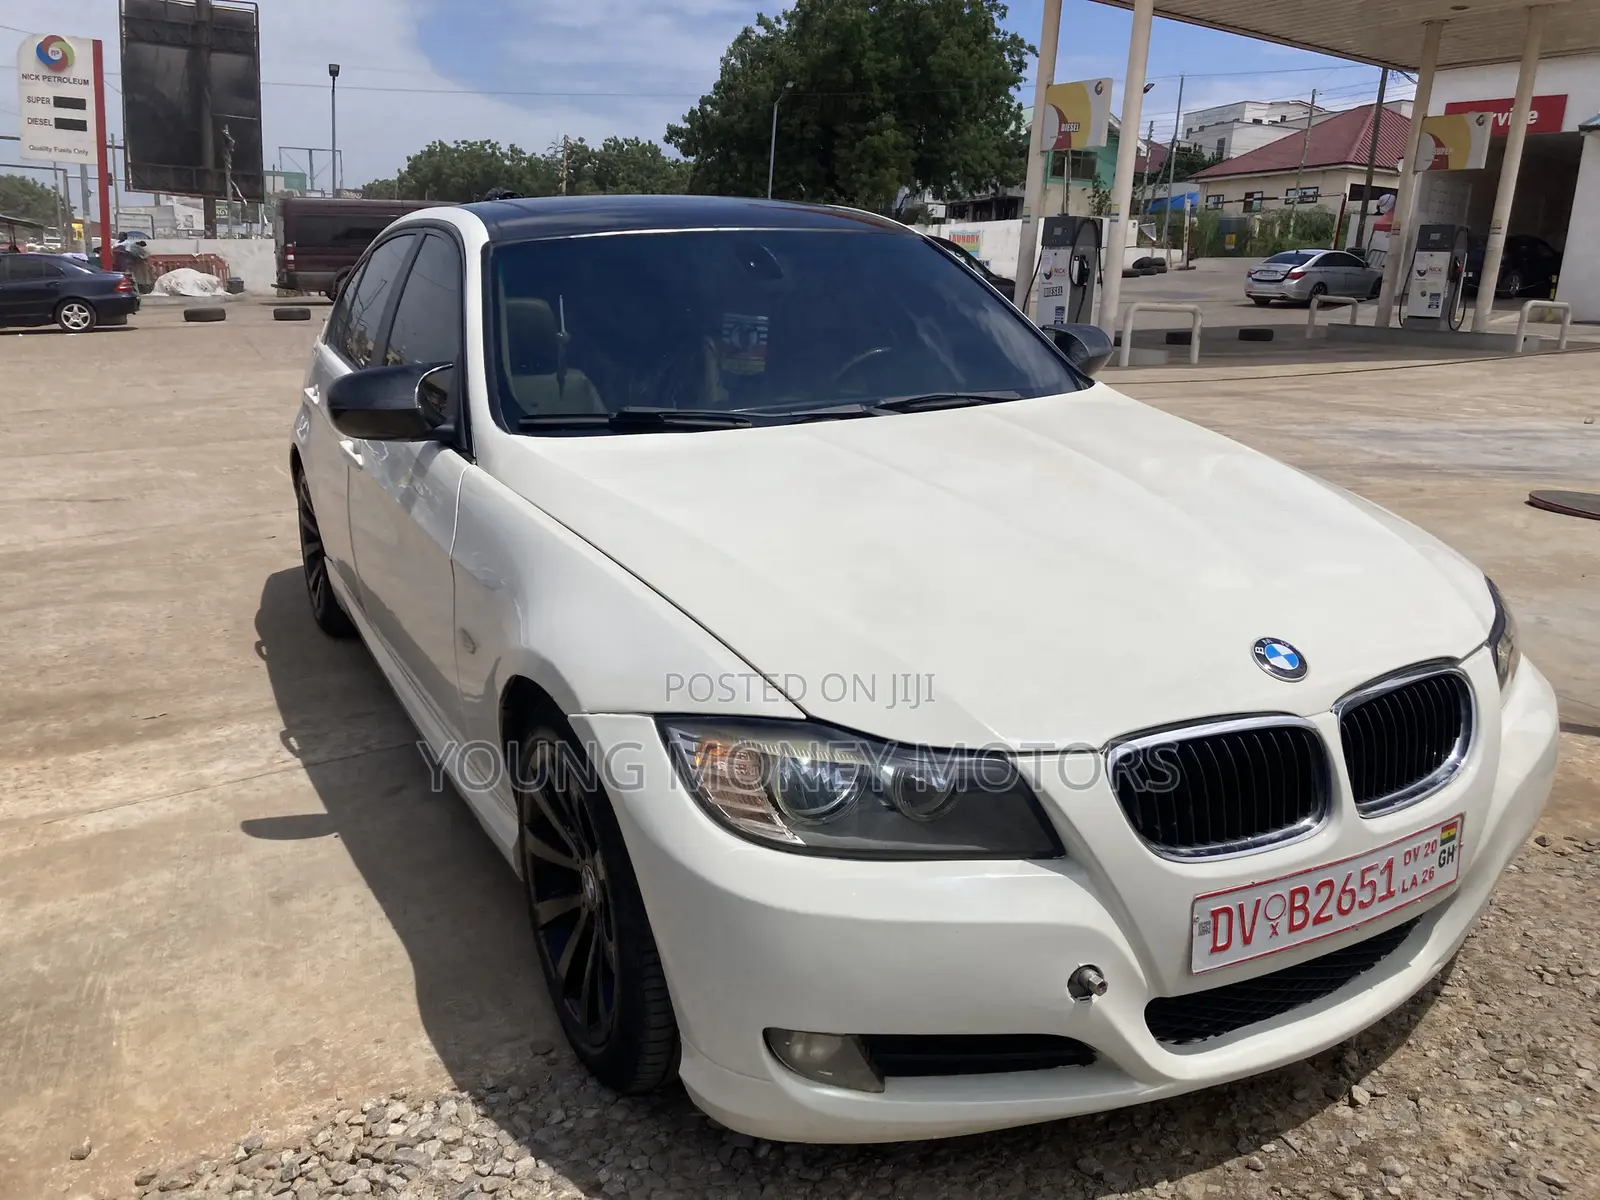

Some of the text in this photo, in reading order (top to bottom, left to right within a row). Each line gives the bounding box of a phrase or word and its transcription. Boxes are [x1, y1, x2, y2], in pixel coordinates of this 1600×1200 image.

[21, 73, 89, 86] NICK PETROLEUM
[26, 96, 51, 105] SUPER
[27, 117, 53, 127] DIESEL
[1060, 123, 1080, 132] DIESEL
[28, 144, 52, 153] Quality
[1044, 286, 1063, 297] DIESEL
[1403, 839, 1438, 866] DV 20
[1438, 848, 1455, 869] GH
[1402, 867, 1435, 893] LA 26
[1288, 856, 1395, 934] B2651
